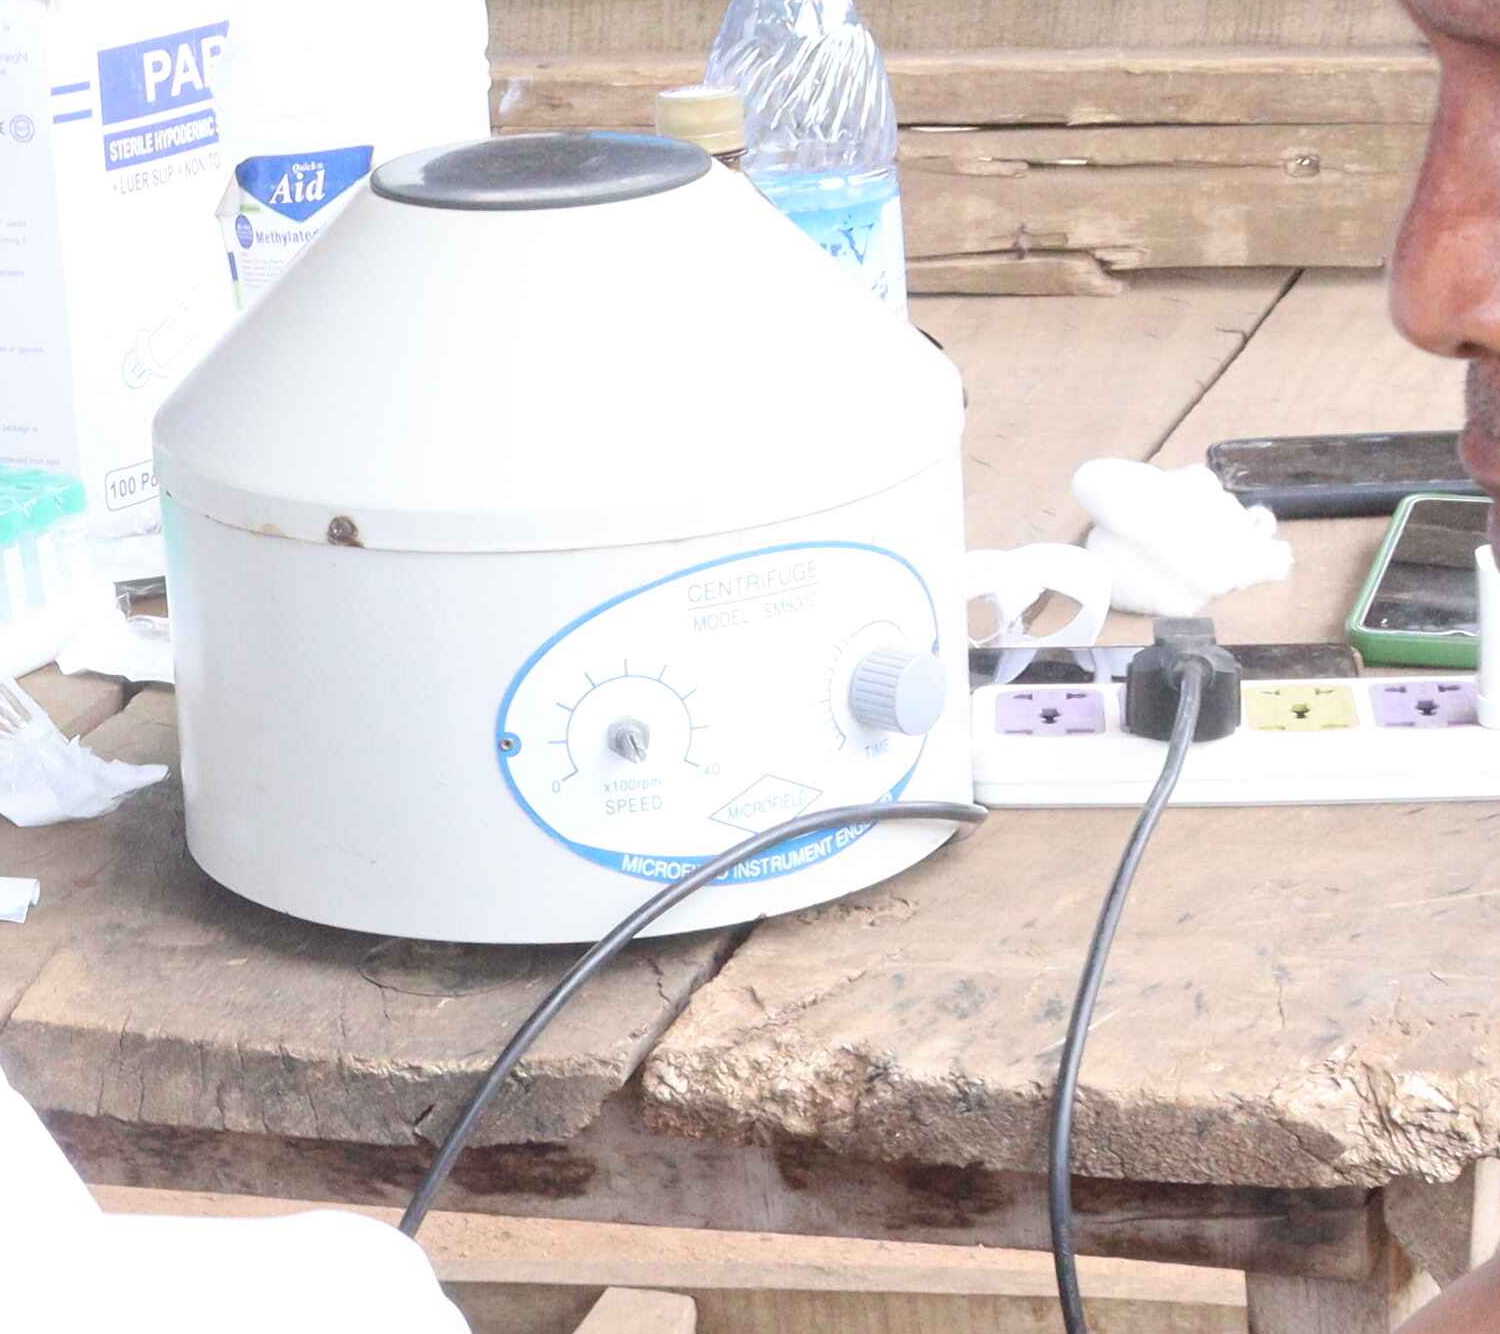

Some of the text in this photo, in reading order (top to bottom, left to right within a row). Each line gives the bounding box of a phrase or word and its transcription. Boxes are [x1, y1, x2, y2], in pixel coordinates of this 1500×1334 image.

[110, 131, 154, 162] STERILE
[119, 172, 150, 195] LUER
[269, 168, 326, 204] Aid
[110, 476, 136, 500] 100
[687, 559, 817, 603] CENTRIFUGE
[693, 607, 749, 633] MODEL
[551, 762, 721, 794] 0 40
[603, 778, 662, 794] x100rpm
[604, 795, 663, 816] SPEED
[727, 790, 808, 819] MICROFIELD
[621, 853, 729, 880] MICROF
[733, 834, 836, 879] INSTRUMENT
